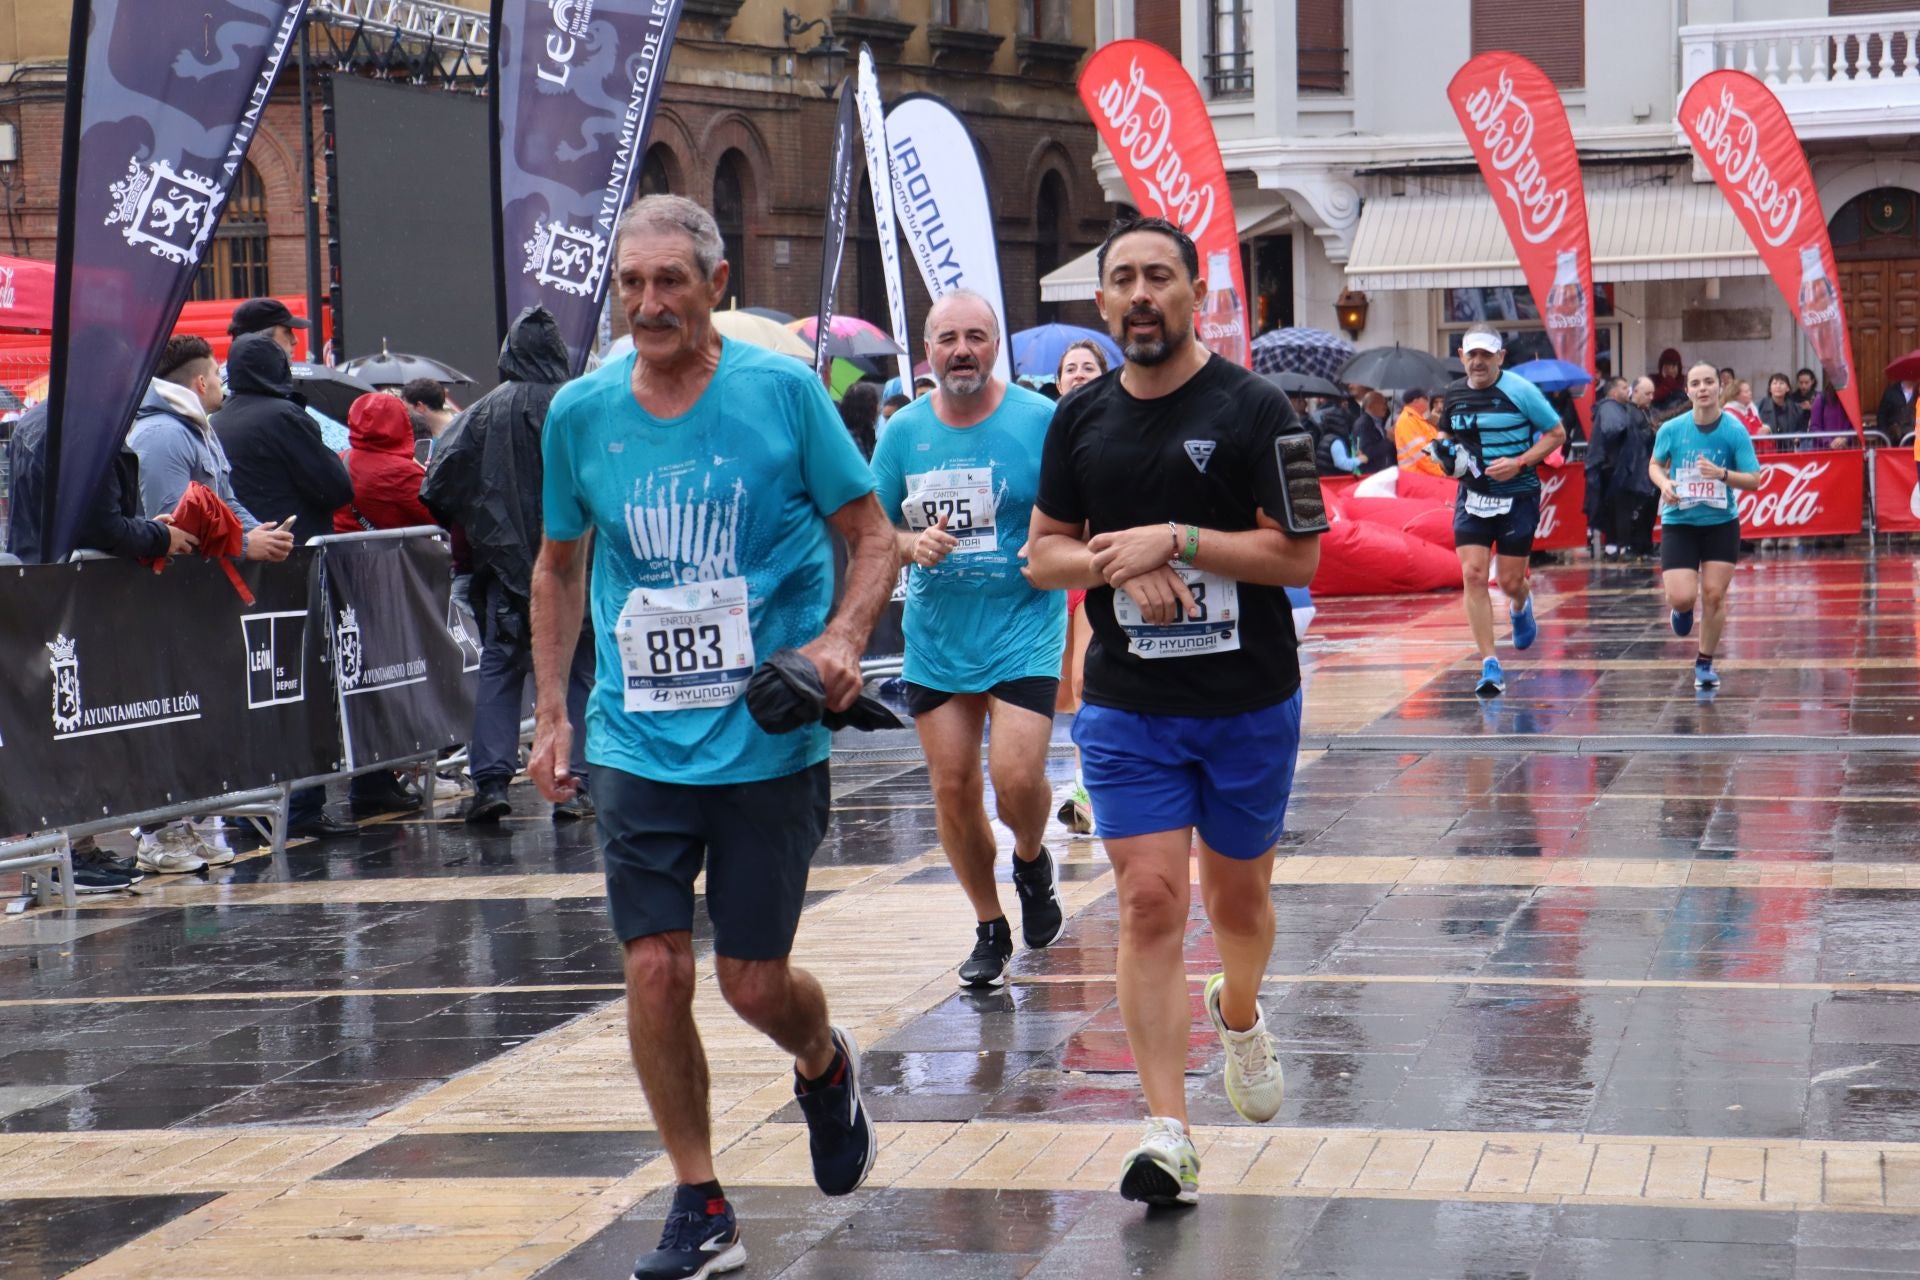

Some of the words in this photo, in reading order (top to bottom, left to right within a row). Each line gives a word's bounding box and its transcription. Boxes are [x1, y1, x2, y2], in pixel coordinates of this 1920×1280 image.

[598, 67, 650, 230] AYUNTAMIENTO
[641, 32, 659, 61] DE
[1884, 204, 1892, 218] 9
[1688, 482, 1714, 497] 978
[921, 498, 973, 531] 825
[660, 614, 703, 627] ENRIQUE
[646, 624, 723, 675] 883
[1159, 635, 1217, 650] HYUNDAI
[250, 642, 271, 672] LEÓN
[276, 667, 284, 677] ES
[674, 685, 736, 701] HYUNDAI
[84, 699, 160, 726] AYUNTAMIENTO
[172, 690, 200, 714] LEÓN
